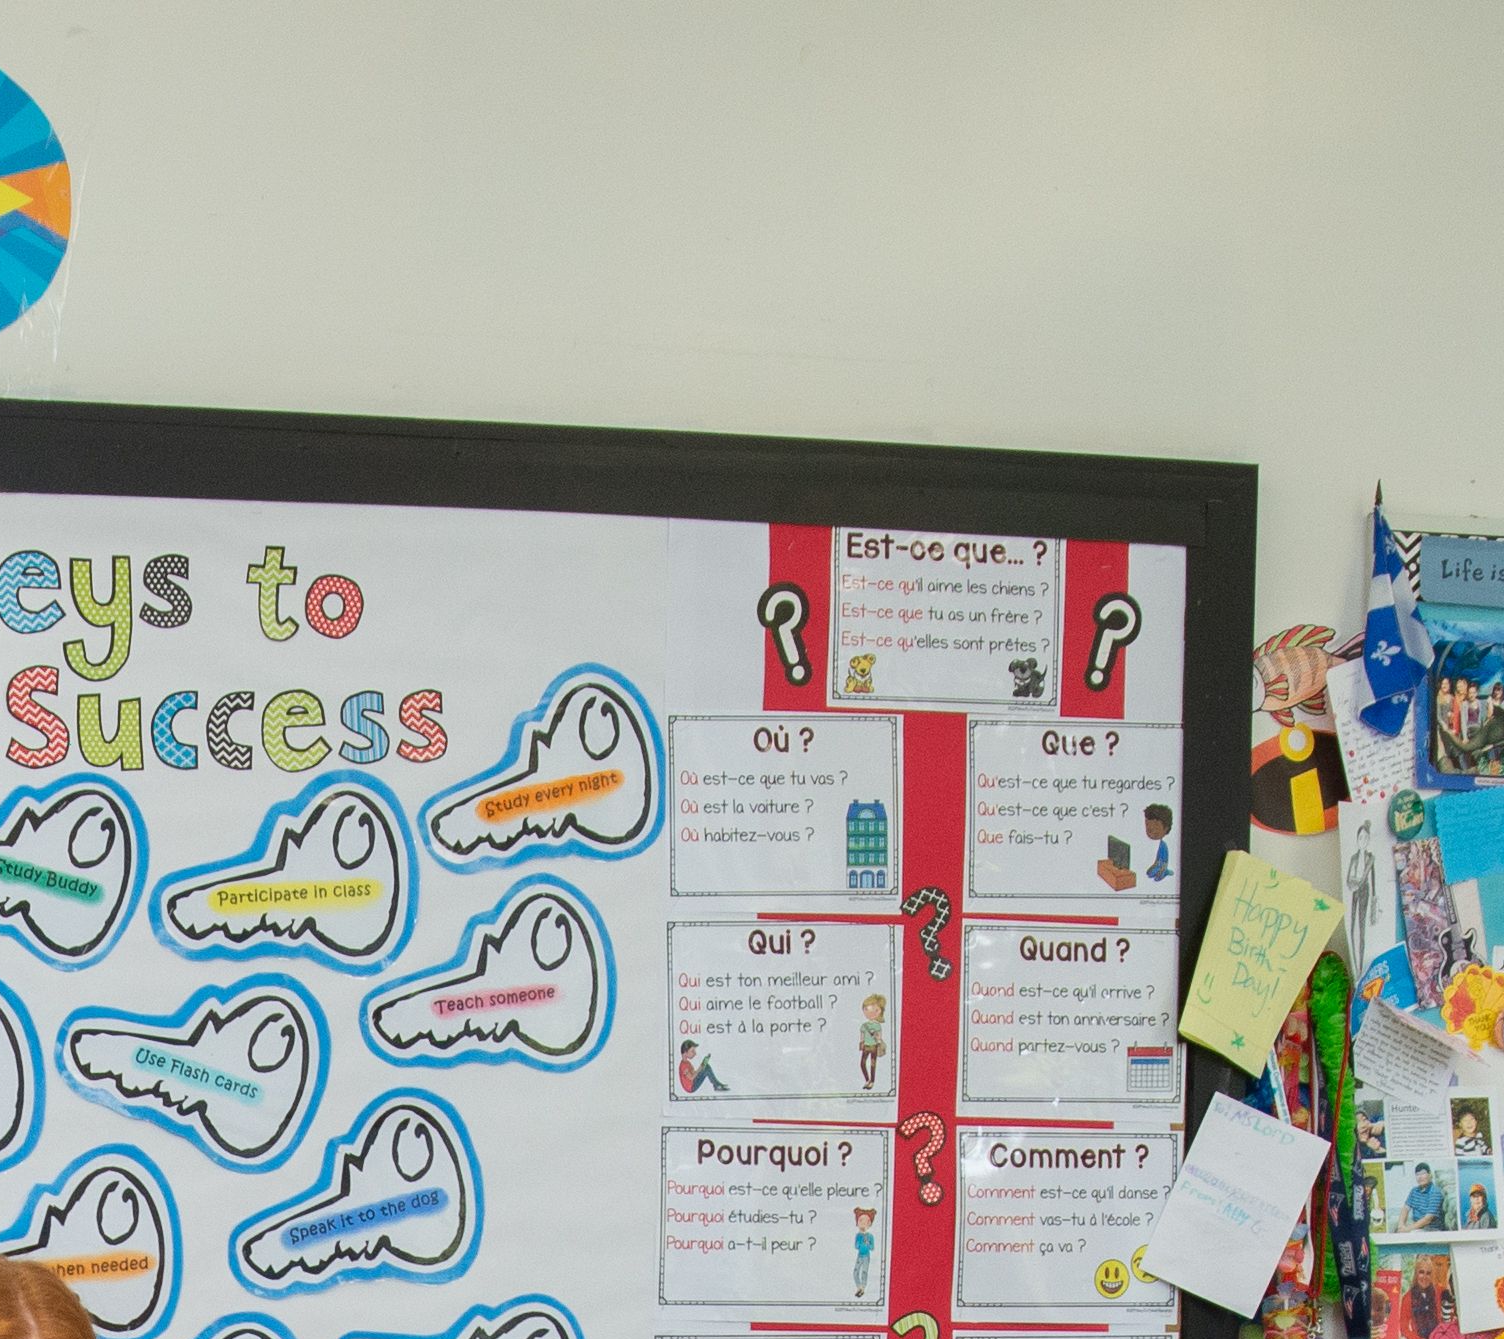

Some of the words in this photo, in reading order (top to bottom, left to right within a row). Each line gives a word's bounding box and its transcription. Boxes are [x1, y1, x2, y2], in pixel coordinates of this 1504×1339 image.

[846, 533, 945, 561] Est-ce
[954, 540, 1025, 569] que...
[1033, 540, 1047, 566] ?
[246, 545, 364, 642] to
[5, 664, 448, 773] Success
[485, 794, 530, 818] Study
[535, 785, 574, 803] every
[578, 772, 618, 792] night
[748, 929, 792, 957] Qui
[800, 929, 816, 953] ?
[1019, 936, 1108, 963] Quand
[1115, 938, 1130, 962] ?
[698, 1139, 830, 1170] Pourquoi
[837, 1142, 853, 1166] ?
[990, 1143, 1127, 1171] Comment
[1134, 1145, 1149, 1169] ?
[289, 1219, 337, 1244] Speak
[341, 1214, 354, 1228] it
[358, 1207, 376, 1222] to
[381, 1202, 407, 1217] the
[411, 1191, 440, 1211] dog
